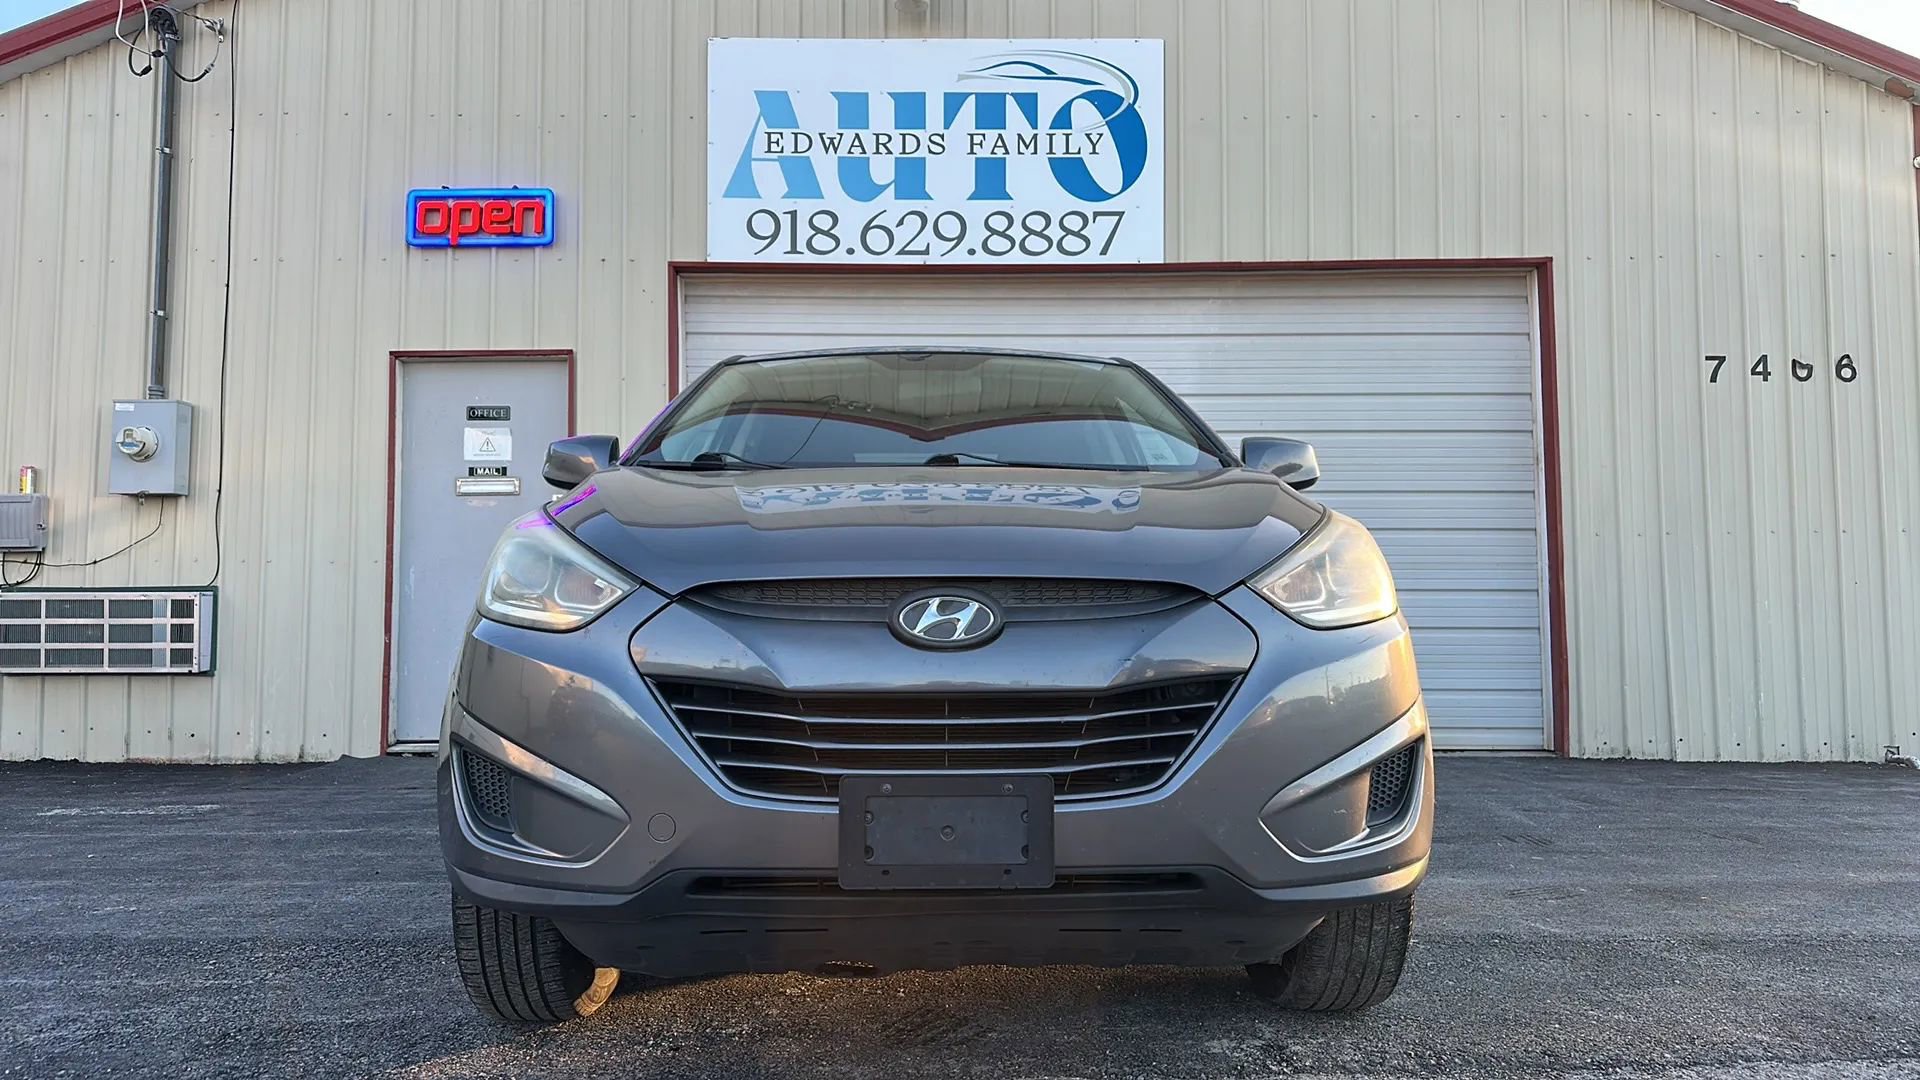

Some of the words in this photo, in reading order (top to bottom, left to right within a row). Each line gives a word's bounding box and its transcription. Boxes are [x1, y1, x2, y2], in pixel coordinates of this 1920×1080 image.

[722, 90, 1148, 202] AUTO
[764, 131, 946, 155] EDWARDS
[967, 131, 1104, 155] FAMILY
[416, 200, 544, 246] open
[746, 208, 1126, 256] 918.629.8887
[470, 409, 507, 418] OFFICE
[477, 467, 498, 475] MAIL
